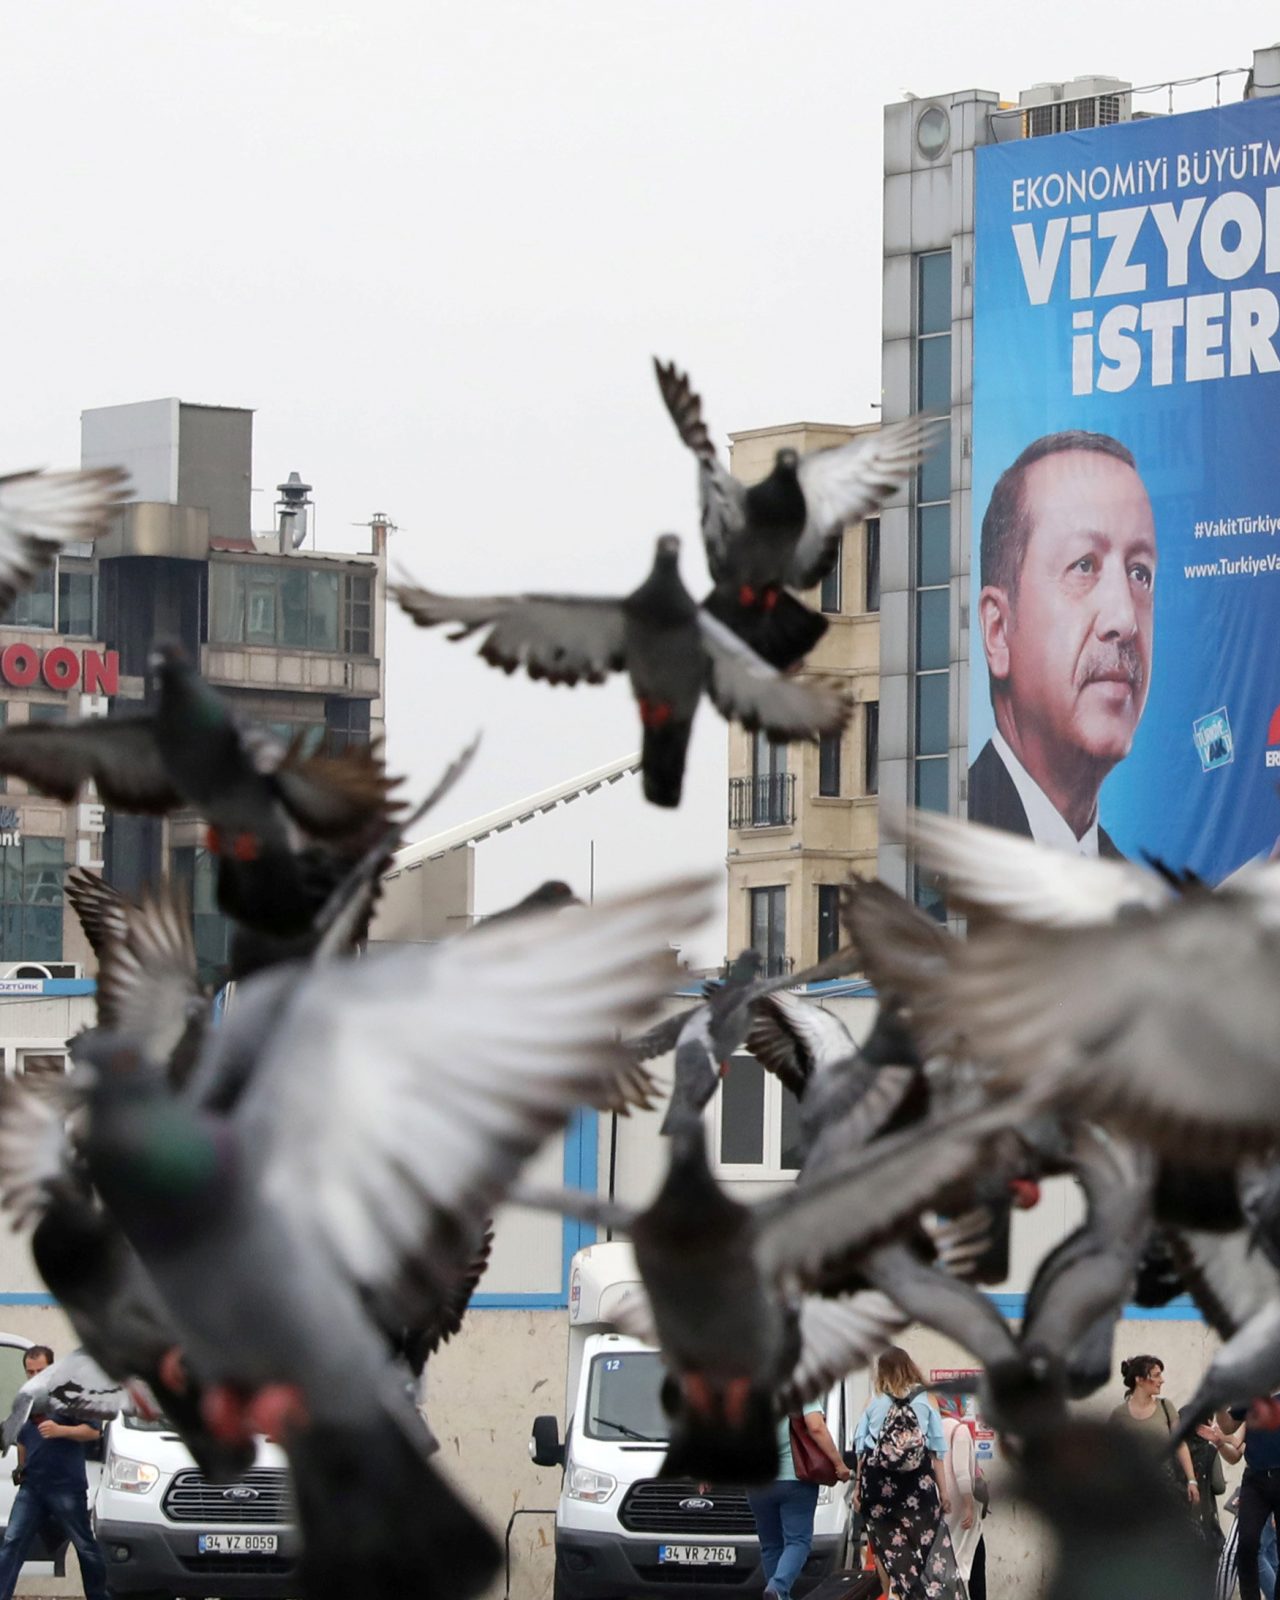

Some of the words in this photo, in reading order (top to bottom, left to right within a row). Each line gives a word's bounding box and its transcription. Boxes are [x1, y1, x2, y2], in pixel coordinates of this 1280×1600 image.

[606, 1360, 620, 1370] 12
[206, 1536, 220, 1549] 34
[226, 1536, 240, 1549] VZ
[245, 1536, 274, 1549] 8059
[666, 1547, 679, 1560] 34
[685, 1547, 699, 1560] VR
[703, 1548, 732, 1561] 2764
